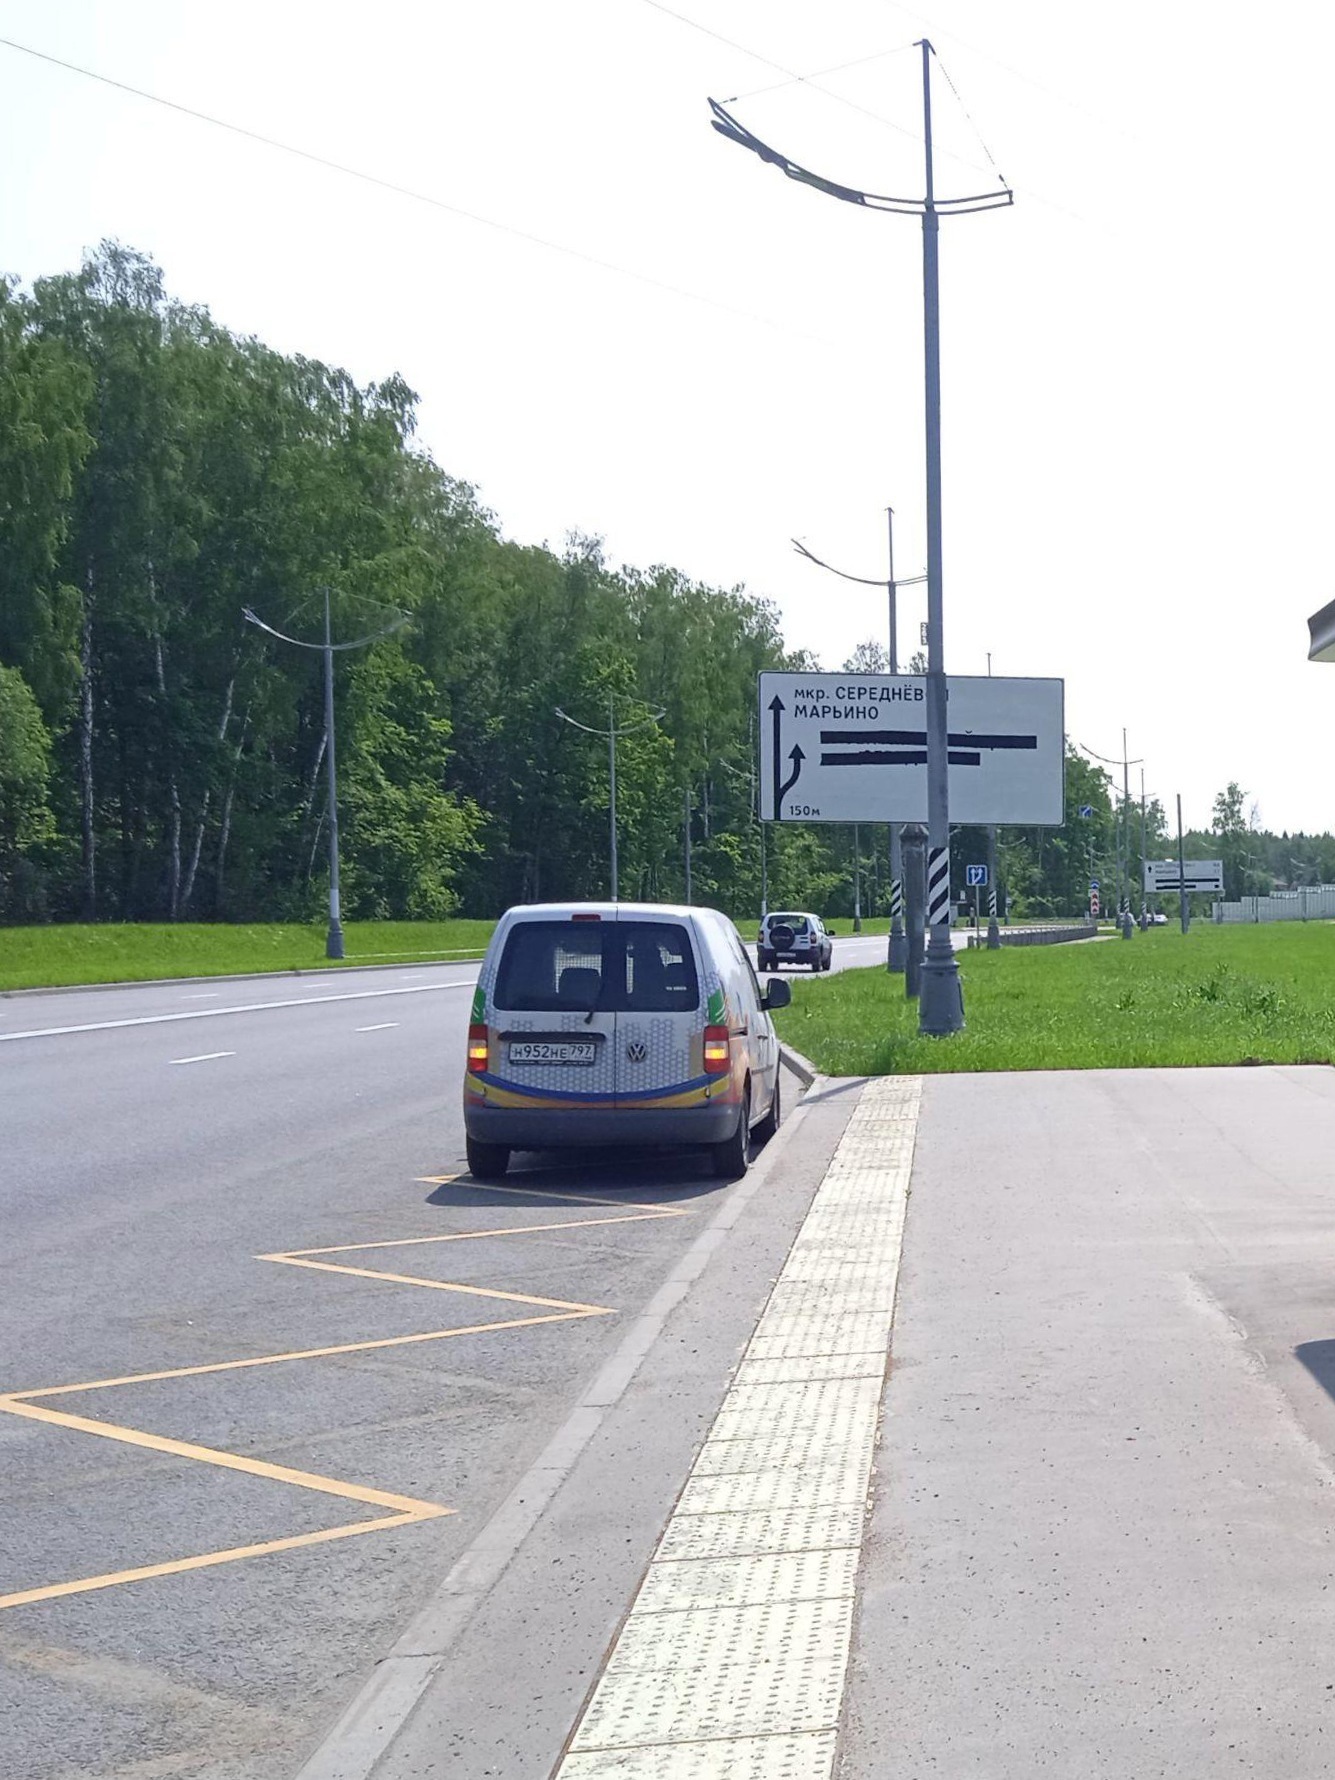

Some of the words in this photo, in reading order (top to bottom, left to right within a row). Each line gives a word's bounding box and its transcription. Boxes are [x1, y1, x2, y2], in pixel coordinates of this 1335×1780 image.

[794, 688, 830, 702] мкр.
[835, 684, 949, 703] СЕРЕДНЁВ
[794, 705, 879, 720] МАРЬИНО
